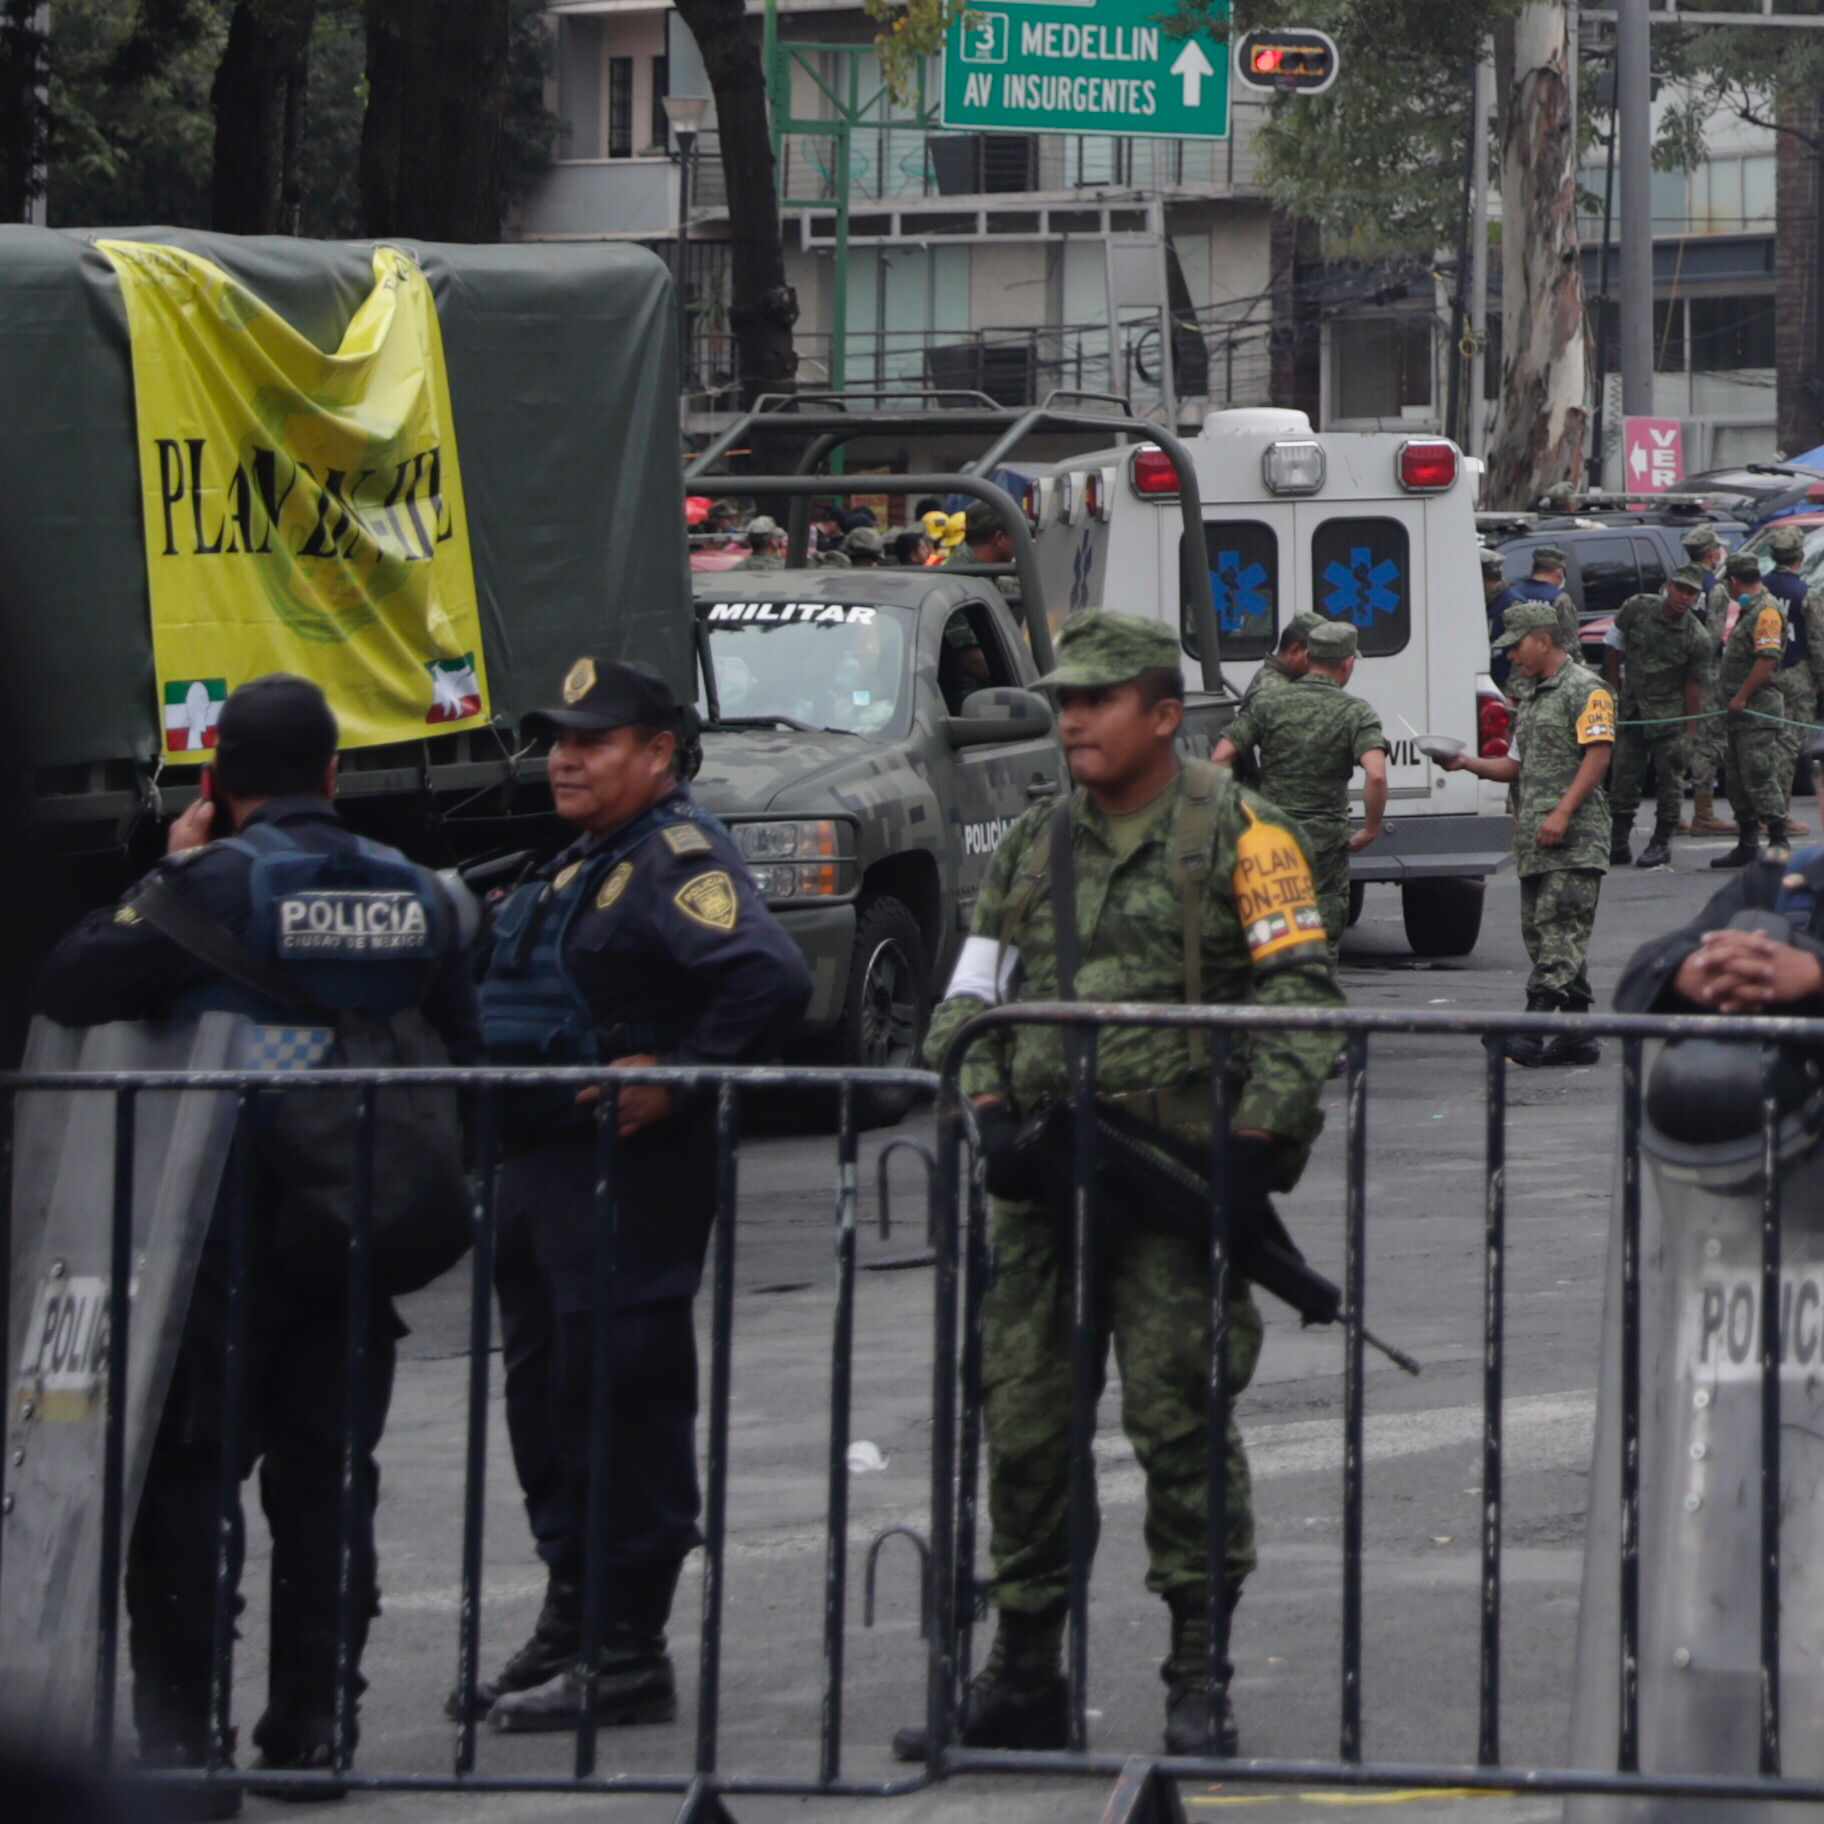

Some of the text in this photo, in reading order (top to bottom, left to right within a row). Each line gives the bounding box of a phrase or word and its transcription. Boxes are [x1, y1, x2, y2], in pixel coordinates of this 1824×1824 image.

[975, 21, 1160, 62] 3 MEDELLIN
[964, 72, 1157, 116] AV INSURGENTES
[1649, 428, 1677, 487] VER
[708, 603, 876, 625] MILITAR
[1240, 847, 1299, 882] PLAN
[281, 896, 428, 933] POLICÍA
